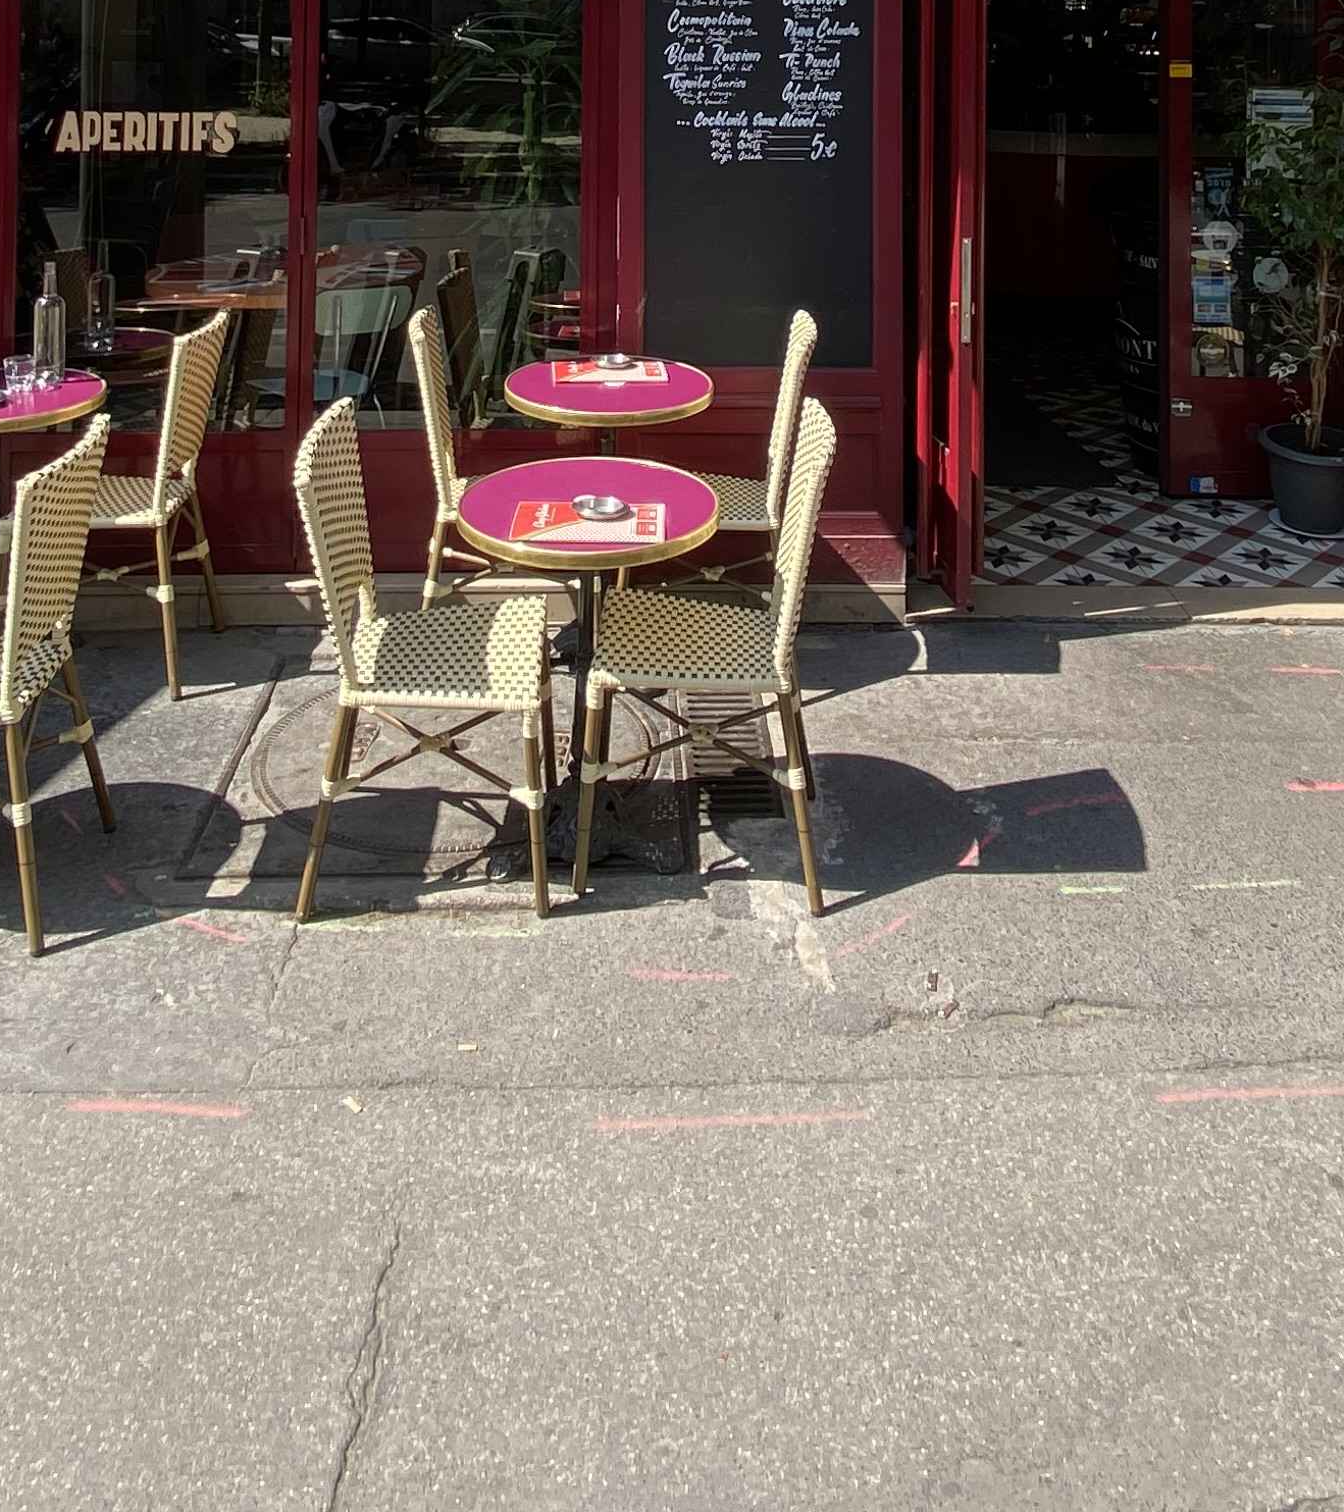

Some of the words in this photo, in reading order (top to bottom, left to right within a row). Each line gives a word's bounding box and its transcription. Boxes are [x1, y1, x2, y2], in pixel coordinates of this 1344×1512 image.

[664, 42, 705, 64] Black
[712, 44, 762, 64] Russian
[805, 52, 840, 68] Punch
[782, 80, 843, 103] Gladines
[56, 110, 238, 153] APERITIFS
